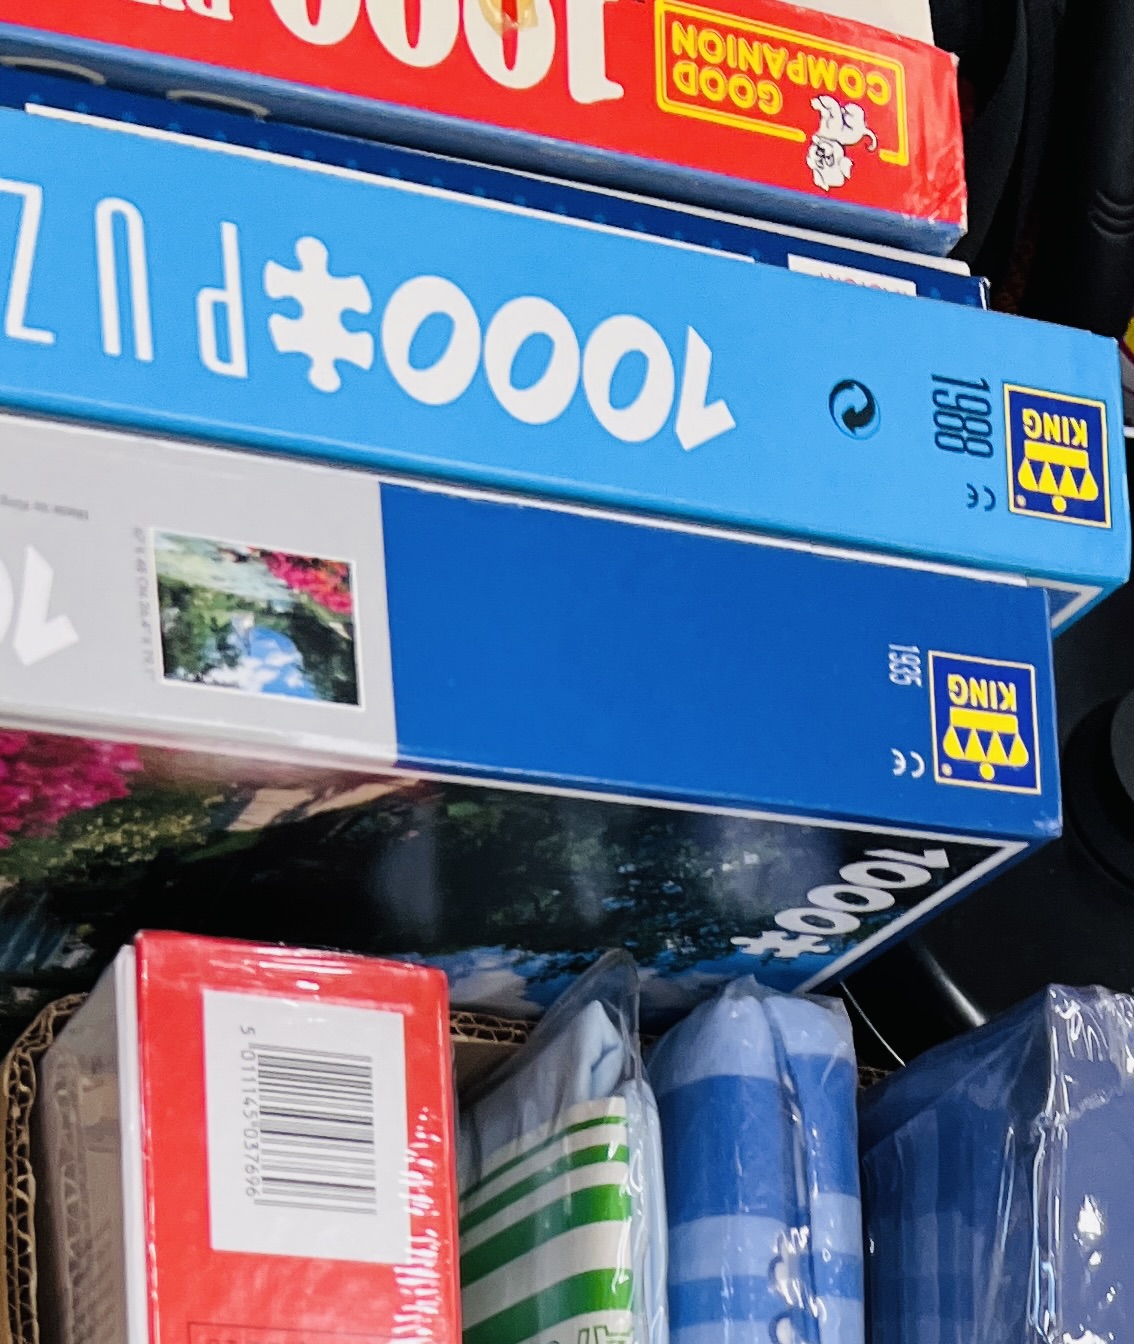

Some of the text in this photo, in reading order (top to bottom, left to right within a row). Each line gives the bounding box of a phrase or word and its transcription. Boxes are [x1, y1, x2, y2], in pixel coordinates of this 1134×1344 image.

[672, 21, 891, 107] COMPANION
[673, 59, 783, 115] GOOD
[0, 178, 737, 452] 1000 PUZ
[930, 373, 994, 460] 1988
[1024, 406, 1088, 447] KING
[948, 674, 1017, 711] KING
[774, 847, 951, 937] 1000
